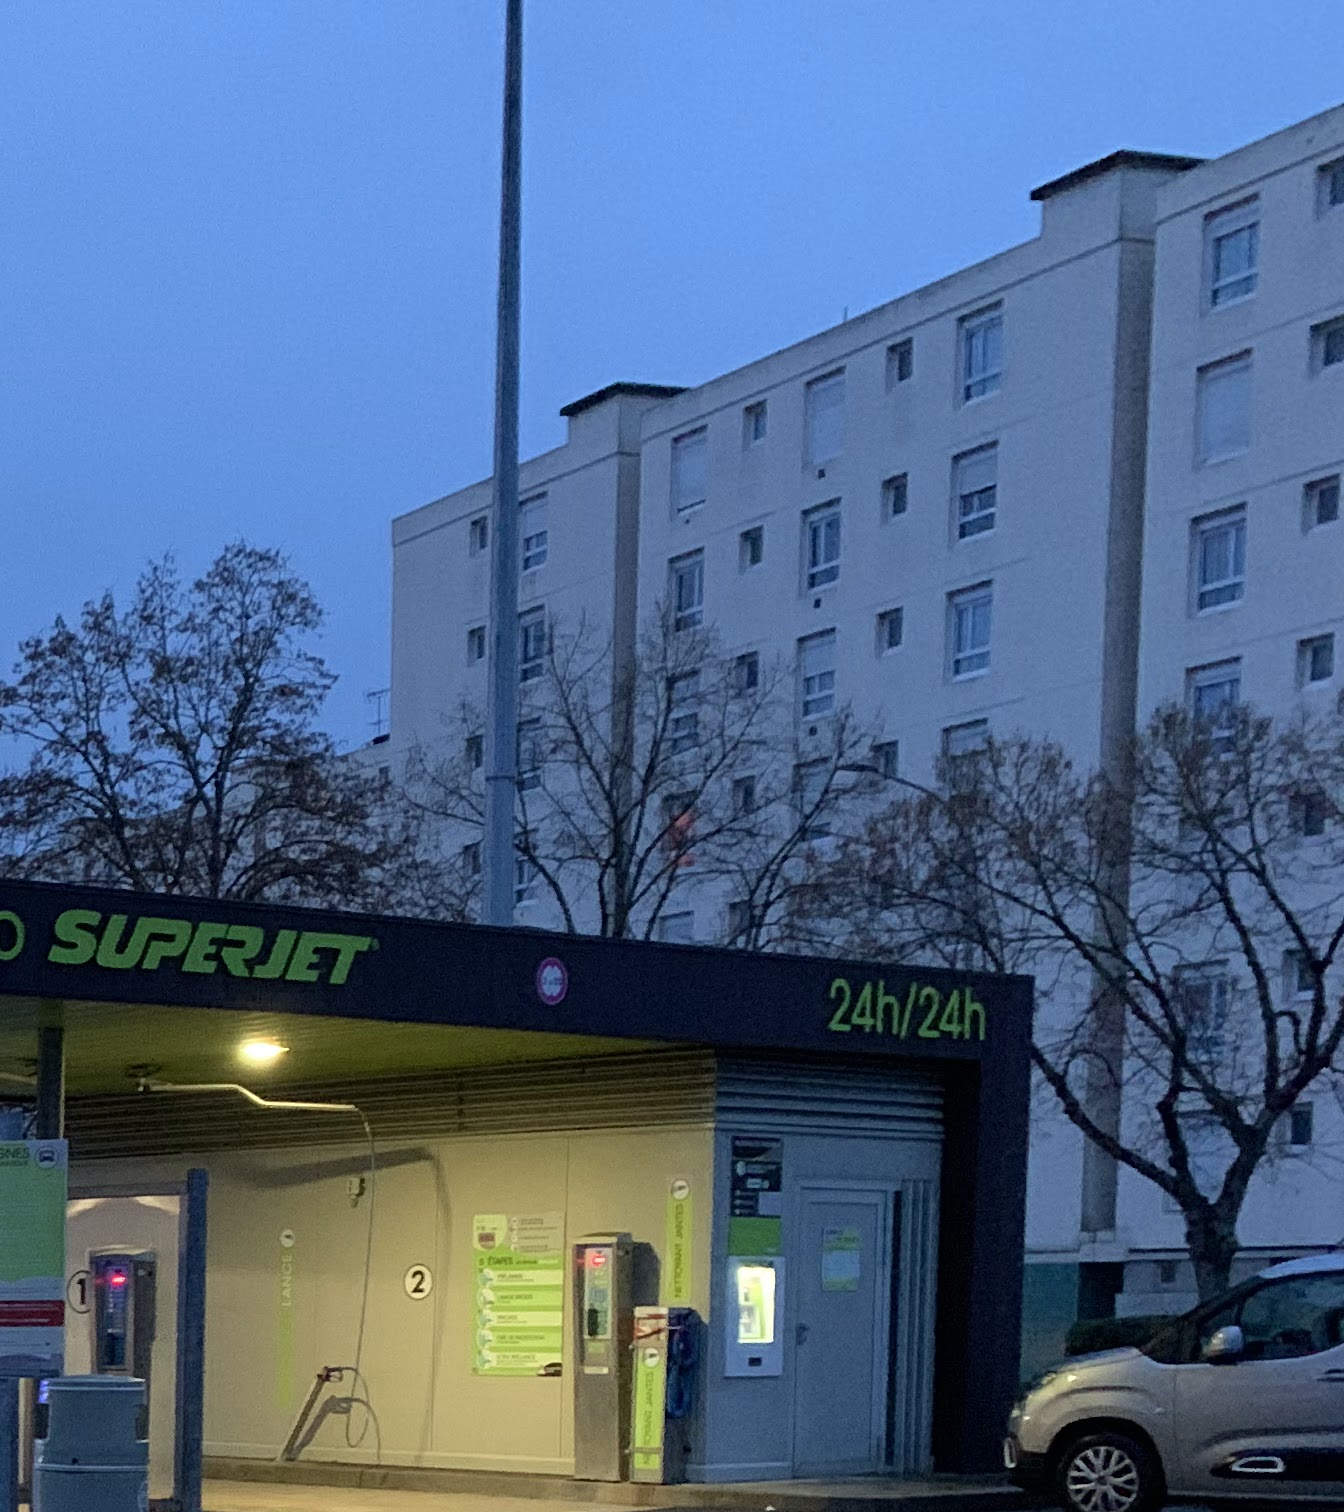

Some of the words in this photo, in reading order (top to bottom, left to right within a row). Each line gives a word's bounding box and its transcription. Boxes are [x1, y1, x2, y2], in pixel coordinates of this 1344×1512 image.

[47, 908, 373, 985] SUPERJET
[827, 977, 987, 1041] 24h/24h
[76, 1278, 87, 1306] 1
[281, 1254, 293, 1307] LANCE
[411, 1269, 426, 1294] 2
